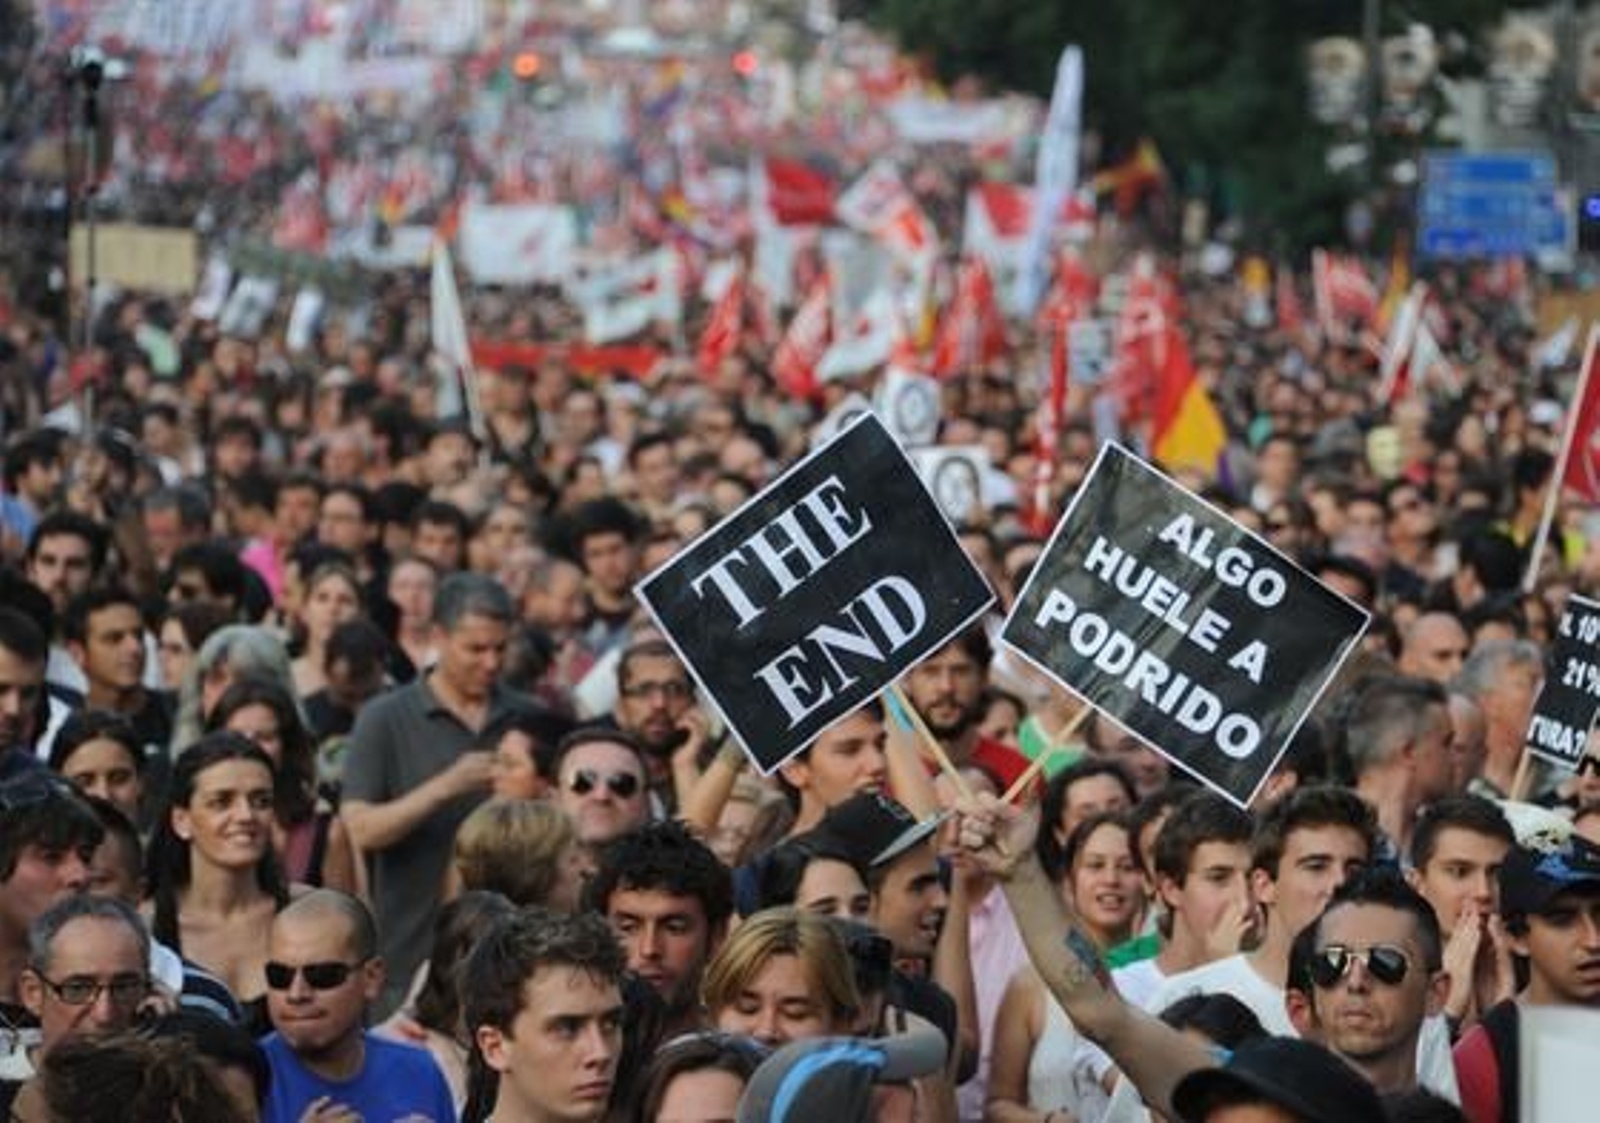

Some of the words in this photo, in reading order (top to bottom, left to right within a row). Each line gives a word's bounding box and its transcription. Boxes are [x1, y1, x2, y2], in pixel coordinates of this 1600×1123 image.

[690, 474, 873, 631] THE
[1083, 536, 1232, 654] HUELE
[1228, 640, 1269, 684] A
[1158, 513, 1287, 607] ALGO
[752, 575, 926, 730] END
[1034, 590, 1261, 759] PODRIDO
